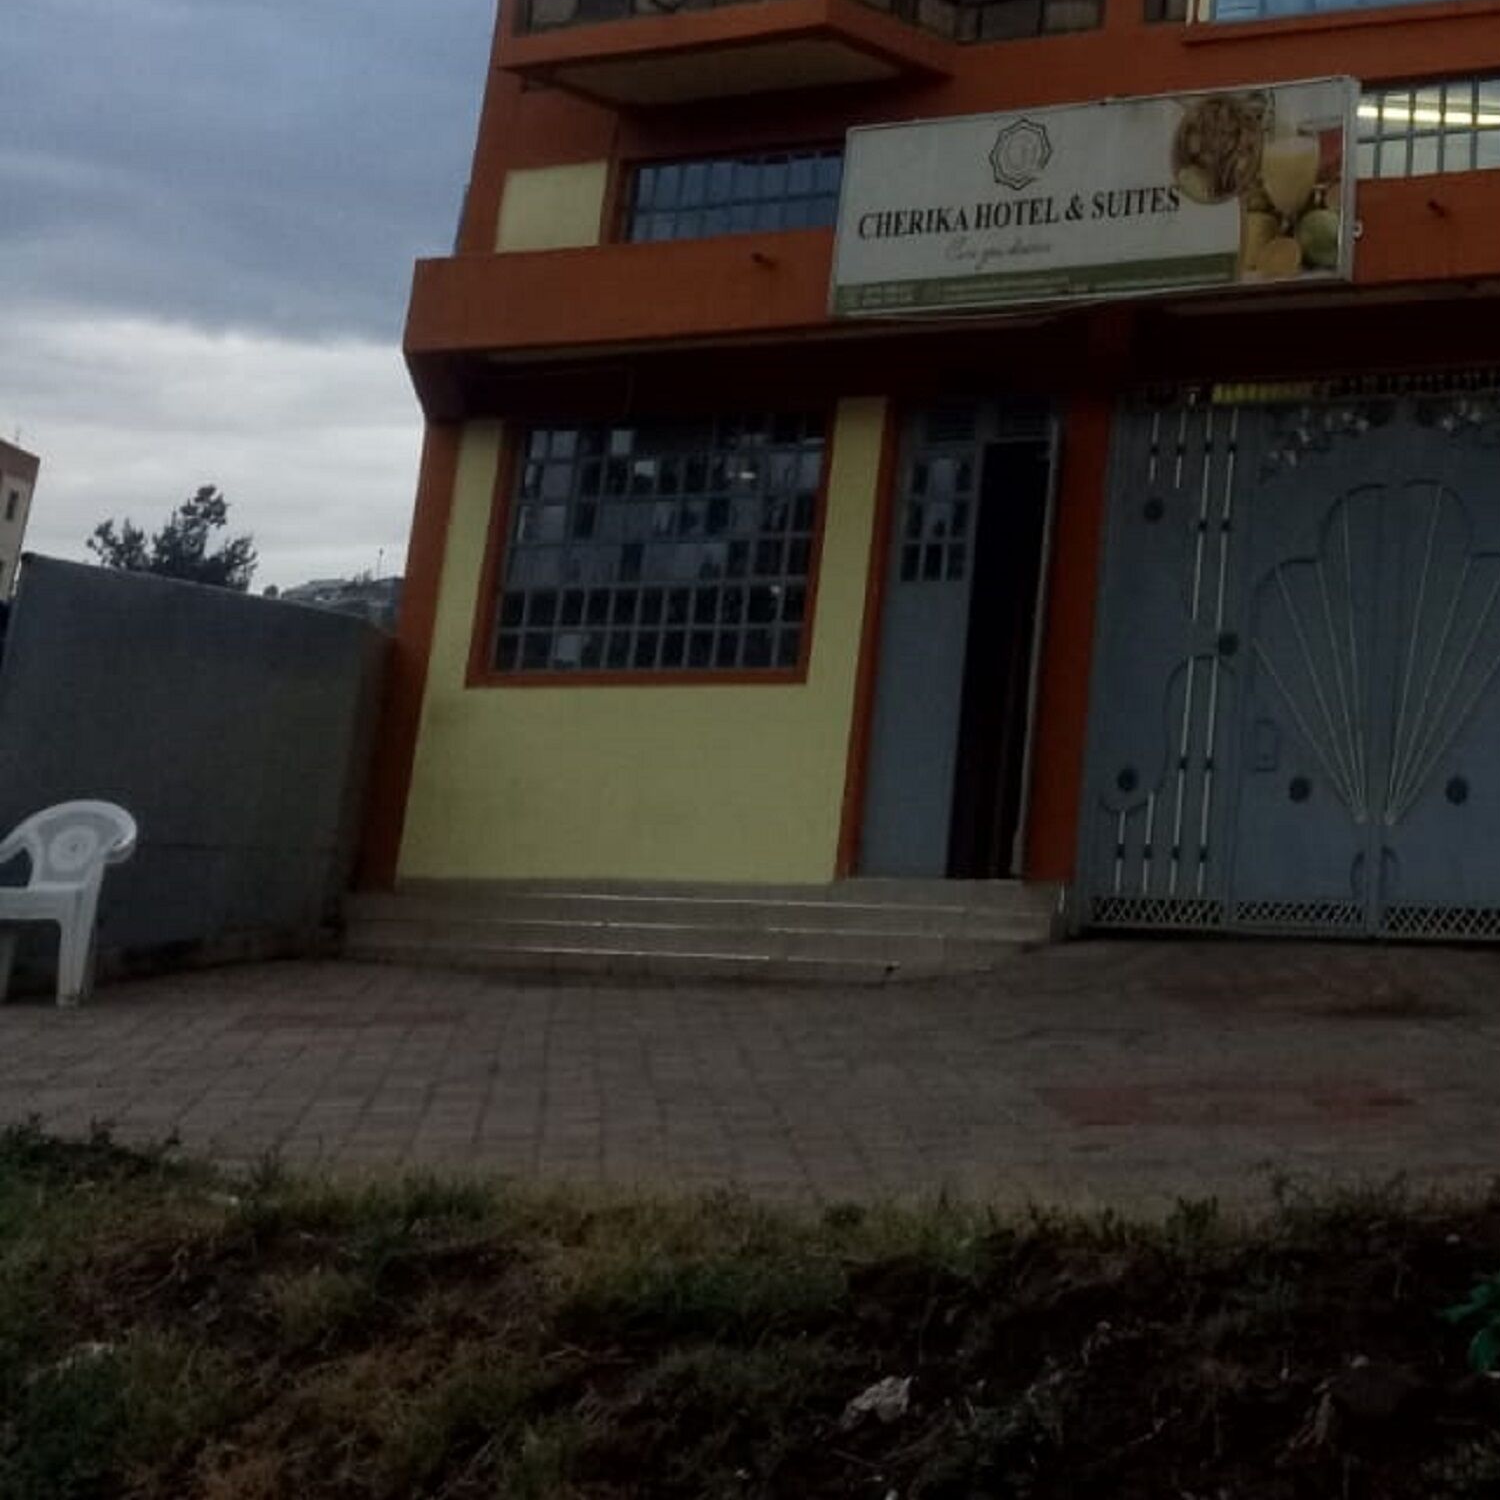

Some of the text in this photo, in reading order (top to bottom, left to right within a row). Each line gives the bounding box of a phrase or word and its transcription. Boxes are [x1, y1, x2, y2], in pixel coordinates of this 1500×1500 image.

[858, 186, 1181, 240] CHERIKA HOTEL & SUITES
